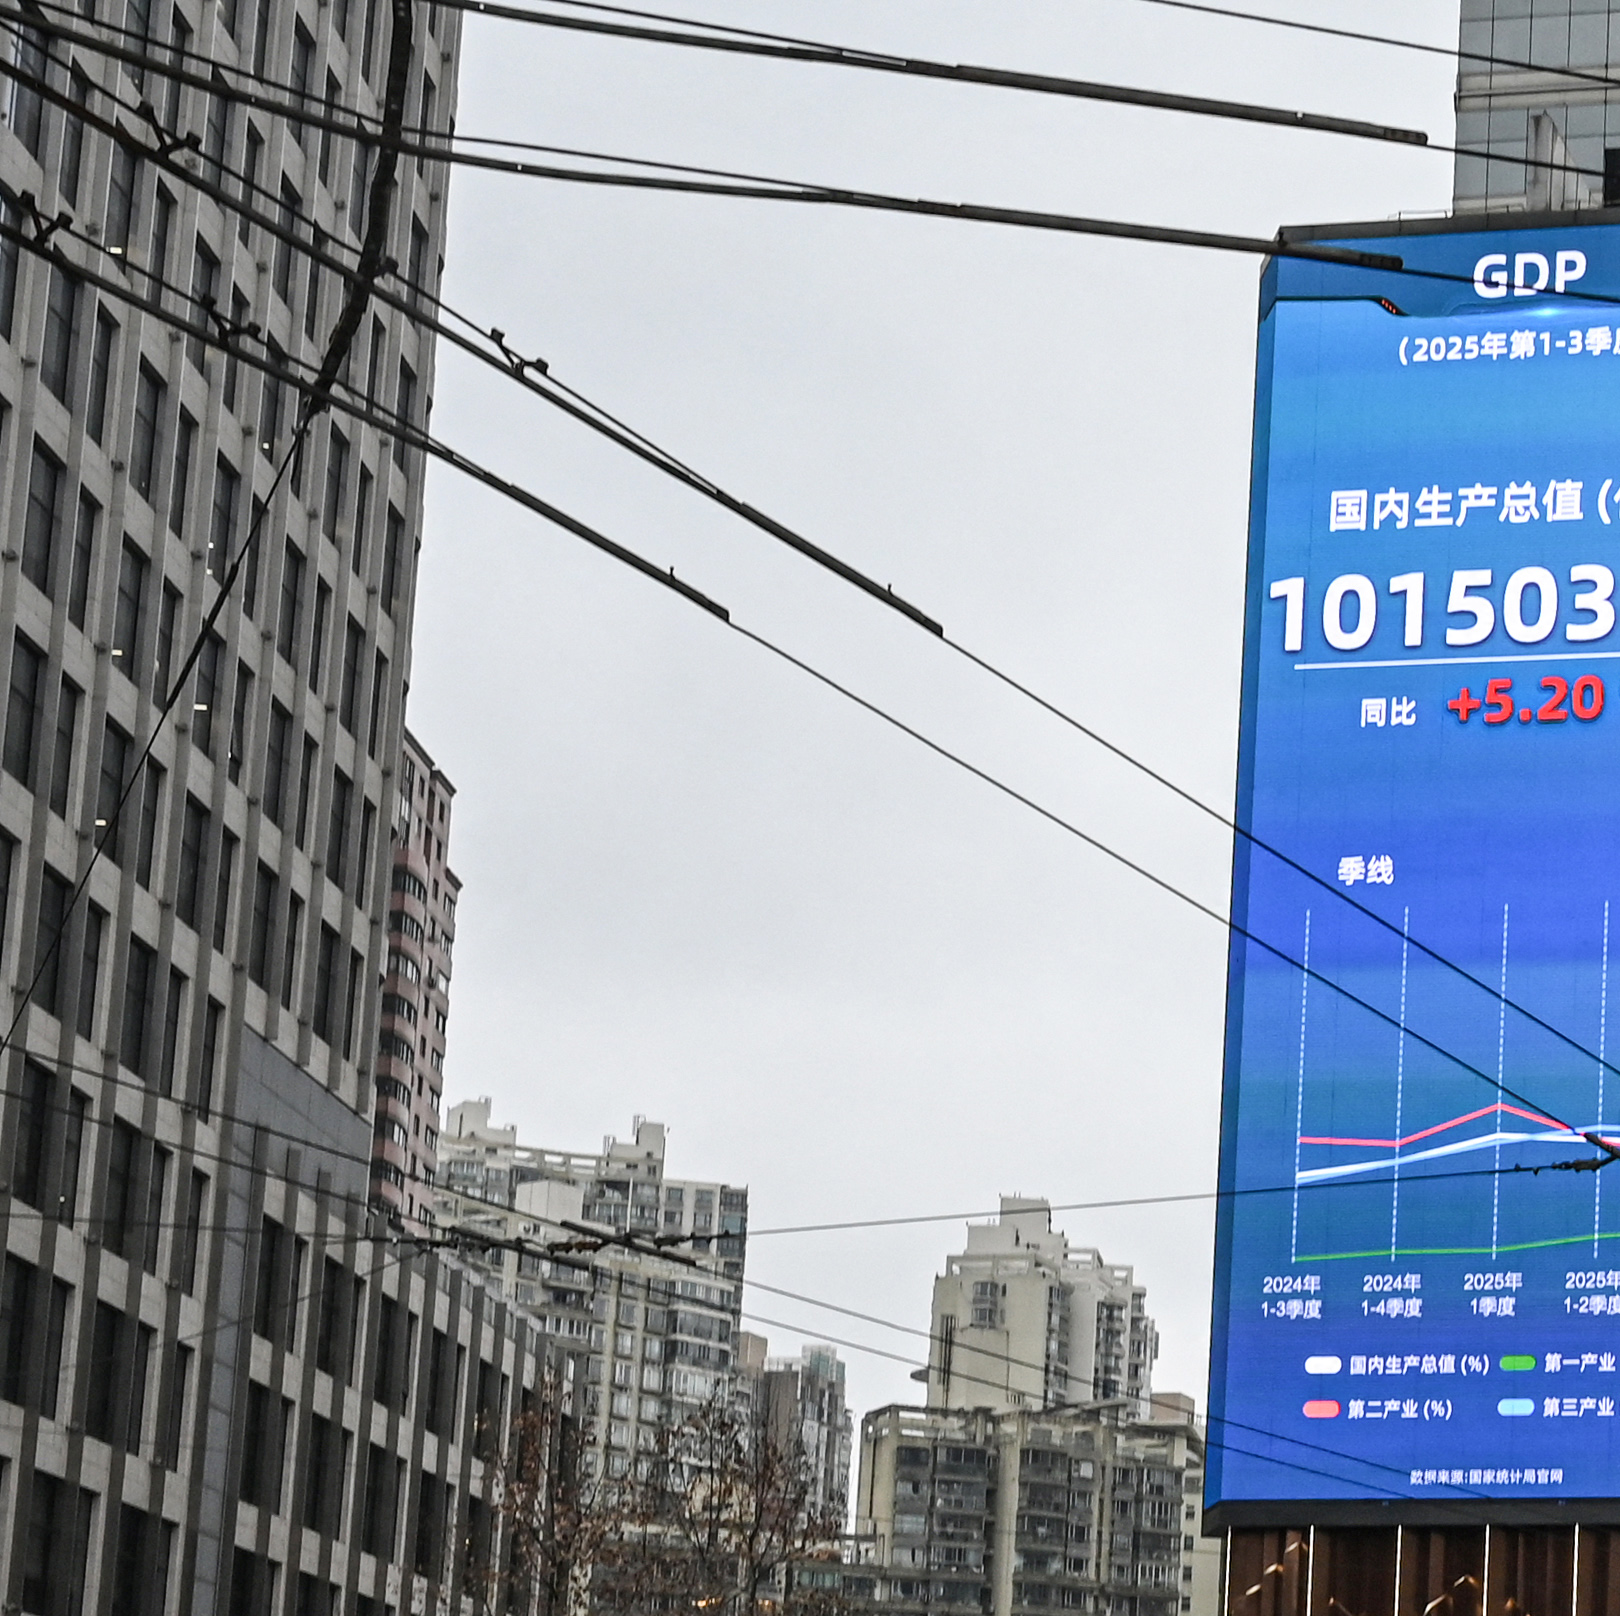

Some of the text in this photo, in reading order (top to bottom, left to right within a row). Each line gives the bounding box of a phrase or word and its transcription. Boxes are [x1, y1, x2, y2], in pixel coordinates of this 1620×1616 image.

[1472, 250, 1588, 300] GDP
[1447, 676, 1605, 725] +5.20
[1360, 696, 1417, 728] 同比
[1338, 854, 1394, 886] 季线
[1263, 1274, 1321, 1295] 2024年
[1363, 1272, 1422, 1293] 2024年
[1463, 1270, 1523, 1291] 2025年
[1261, 1298, 1322, 1320] 1-3季度
[1361, 1297, 1422, 1319] 1-4季度
[1470, 1295, 1516, 1317] 1季度
